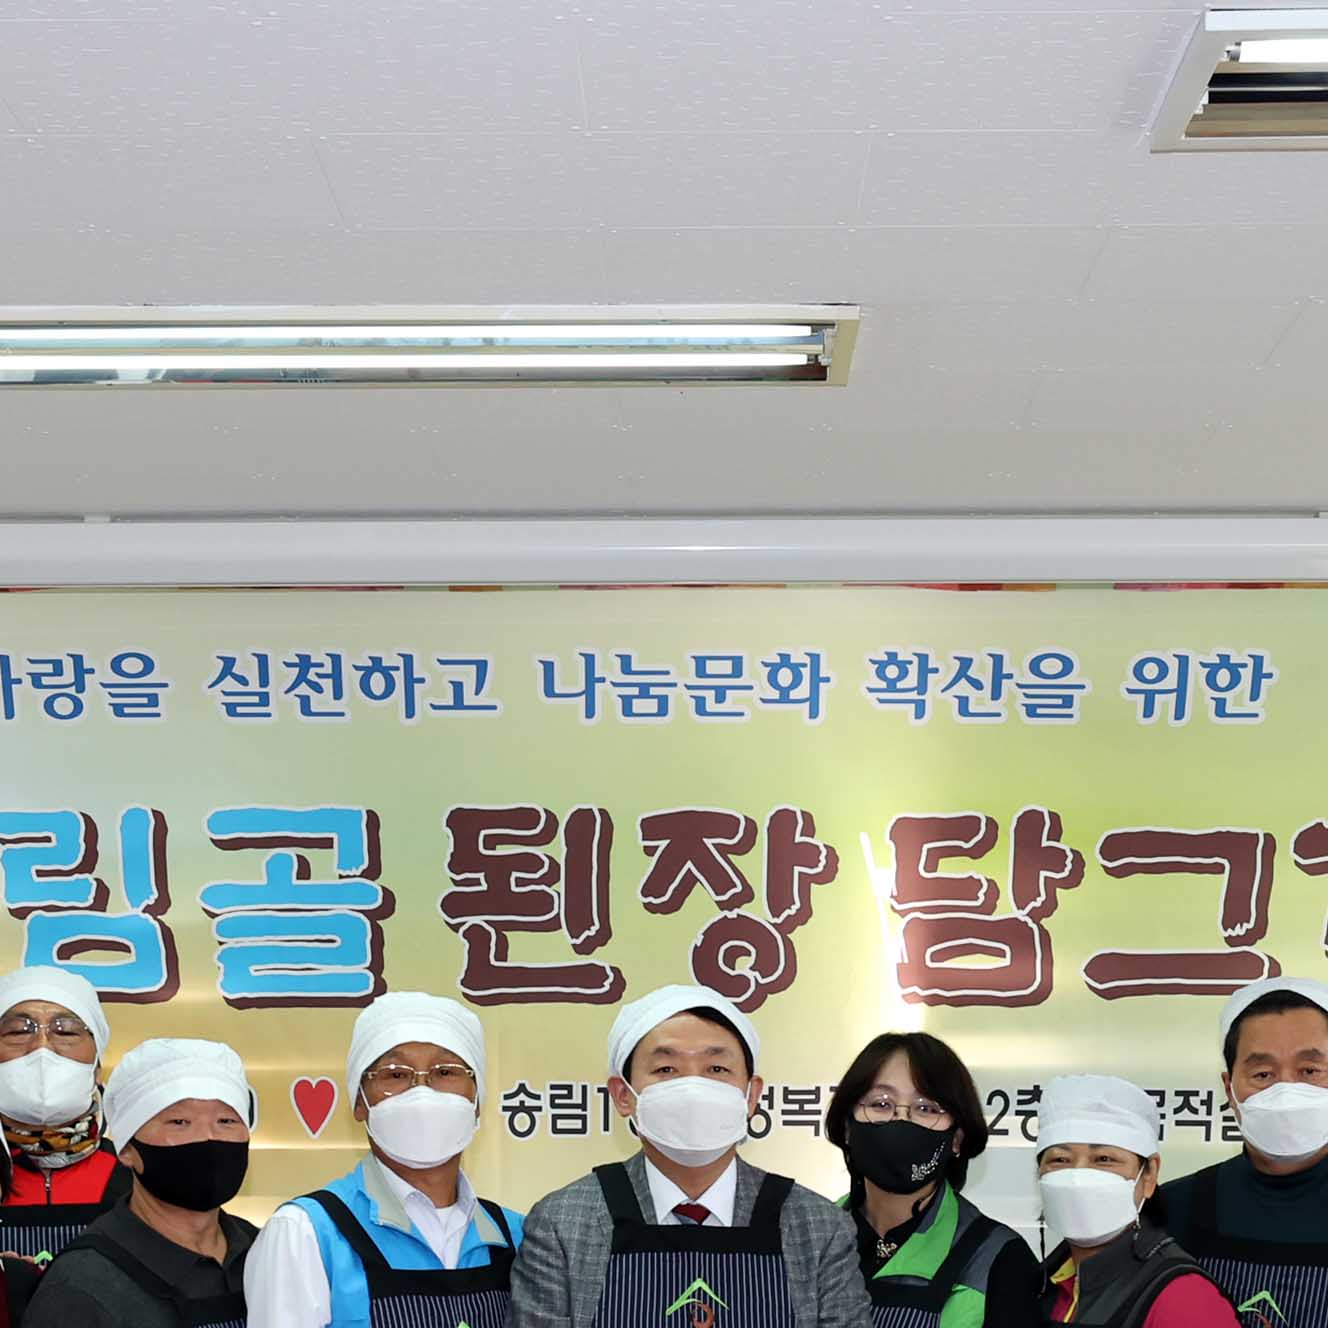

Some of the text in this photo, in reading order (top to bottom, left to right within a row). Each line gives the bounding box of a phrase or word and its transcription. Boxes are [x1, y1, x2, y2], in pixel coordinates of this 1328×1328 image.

[210, 653, 497, 720] 실천하고
[542, 652, 831, 720] 나눔문화
[869, 651, 1084, 719] 확산을
[1128, 653, 1274, 721] 위한
[442, 806, 839, 1012] 된장
[501, 1082, 639, 1138] 송림1
